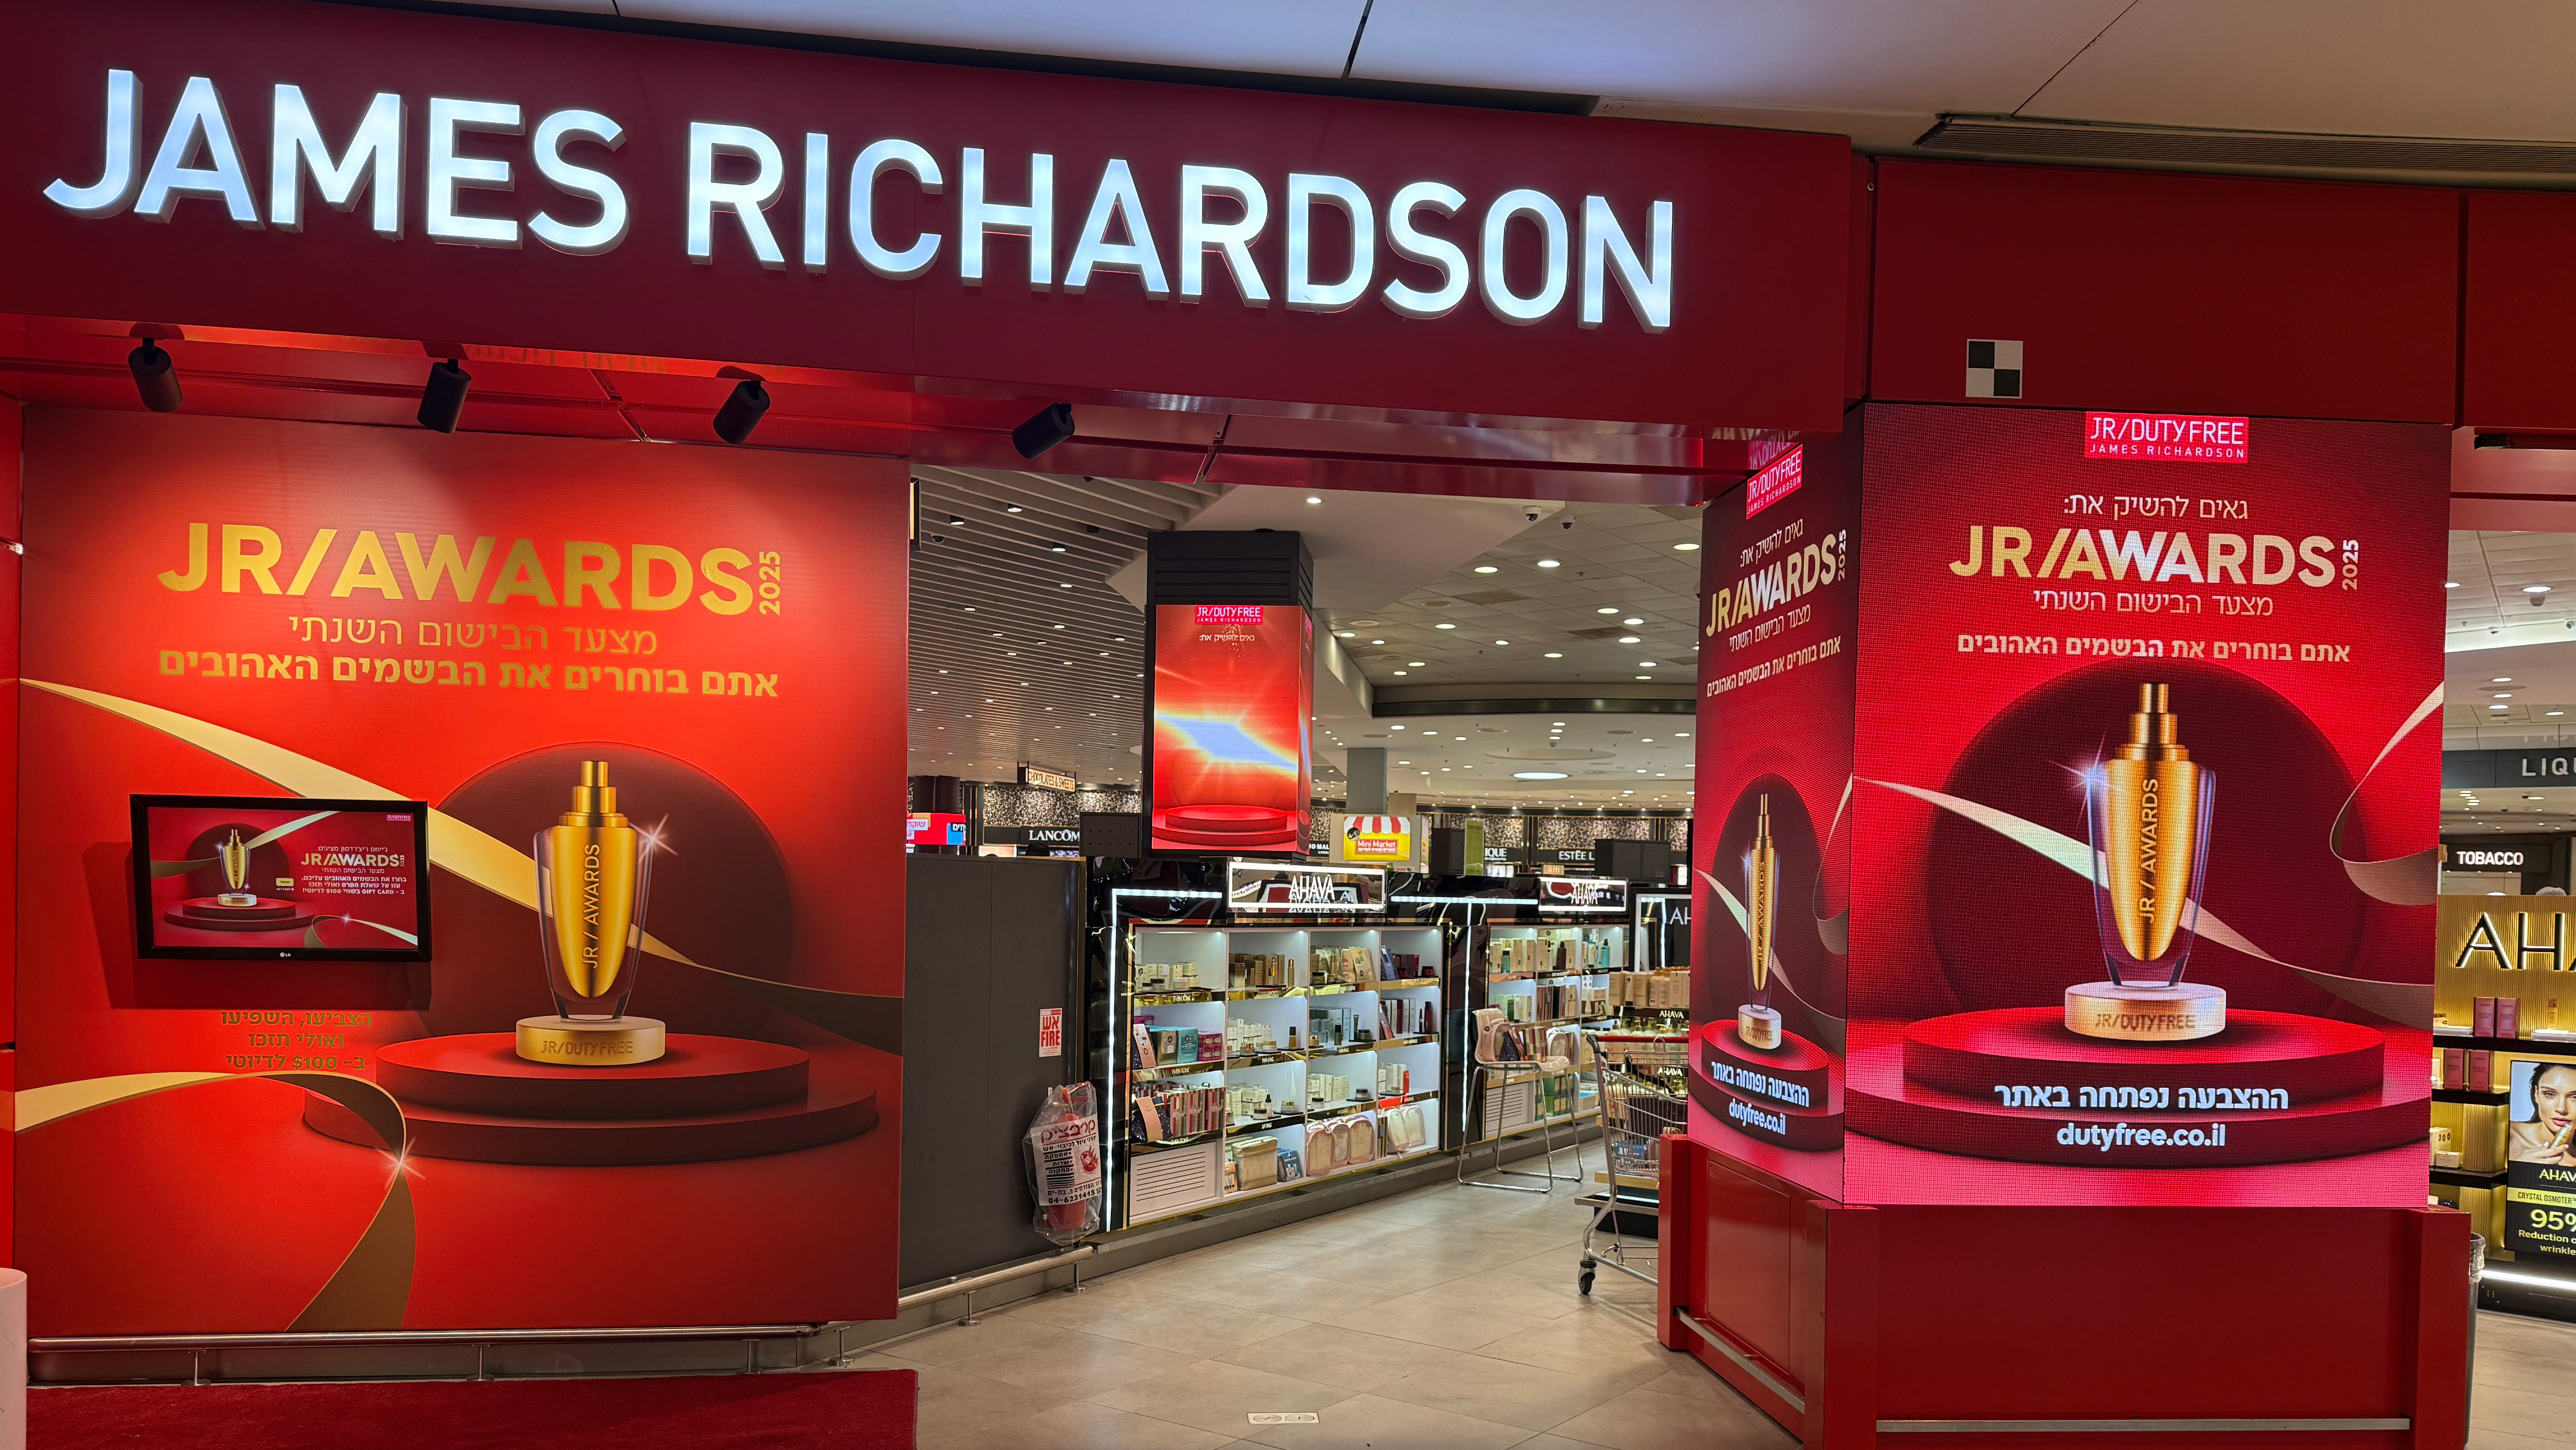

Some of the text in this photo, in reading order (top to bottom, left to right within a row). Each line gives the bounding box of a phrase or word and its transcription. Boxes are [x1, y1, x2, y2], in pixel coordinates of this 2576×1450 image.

[42, 69, 1675, 332] JAMES RICHARDSON
[2090, 417, 2244, 445] JR/DUTYFREE
[2090, 444, 2244, 458] JAMES RICHARDSON
[1748, 450, 1802, 503] JR/DUTYFREE
[1747, 475, 1801, 514] JAMES RICHARDSON
[2064, 494, 2248, 521] גאים להשיק את:
[1740, 518, 1803, 568] גאים להשיק את:
[1837, 529, 1847, 582] 2025
[1948, 525, 2336, 587] JR/AWARDS
[157, 522, 754, 616] JR/AWARDS
[2342, 539, 2359, 591] 2025
[758, 550, 781, 616] 2025
[1706, 533, 1837, 637] JR/AWARDS
[1197, 606, 1261, 617] JR/DUTYFREE
[2033, 590, 2273, 616] מצעד הבישום השנתי
[288, 616, 657, 655] מצעד הבישום השנתי
[1729, 604, 1811, 652] מצעד הבישום השנתי
[1957, 634, 2350, 663] אתם בוחרים את הבשמים האהובים
[159, 650, 778, 697] אתם בוחרים את הבשמים האהובים
[1707, 635, 1841, 697] אתם בוחרים את הבשמים האהובים
[2522, 757, 2576, 776] LIQ
[1058, 777, 1074, 790] SWEETS
[2140, 778, 2159, 873] AWARDS
[300, 853, 401, 867] JR/AWARDS
[1485, 847, 1507, 858] IQUE
[2456, 851, 2524, 866] TOBACCO
[583, 844, 600, 926] AWARDS
[1288, 874, 1335, 900] AHAVA
[2138, 896, 2156, 923] JR
[2455, 911, 2576, 971] AH
[582, 947, 599, 969] JR
[221, 1011, 372, 1027] הצביעו, השפיעו
[1043, 1016, 1059, 1030] אש
[1659, 1010, 1684, 1019] AHAVA
[248, 1033, 344, 1048] ואולי תזכו
[1041, 1030, 1060, 1047] FIRE
[226, 1054, 286, 1069] לדיוטי
[292, 1054, 337, 1070] $100
[1657, 1066, 1683, 1077] AHAVA
[1711, 1061, 1810, 1108] ההצבעה נפתחה באתר
[1994, 1085, 2289, 1109] ההצבעה נפתחה באתר
[1729, 1098, 1786, 1135] dutyfree.co.il
[1043, 1141, 1075, 1151] לכיבוי-אש
[2057, 1122, 2226, 1152] dutyfree.co.il
[1048, 1189, 1095, 1204] 04-6231415
[2518, 1191, 2543, 1201] CRYSTAL
[2518, 1229, 2569, 1243] Reduction
[2539, 1245, 2576, 1256] wrinkle
